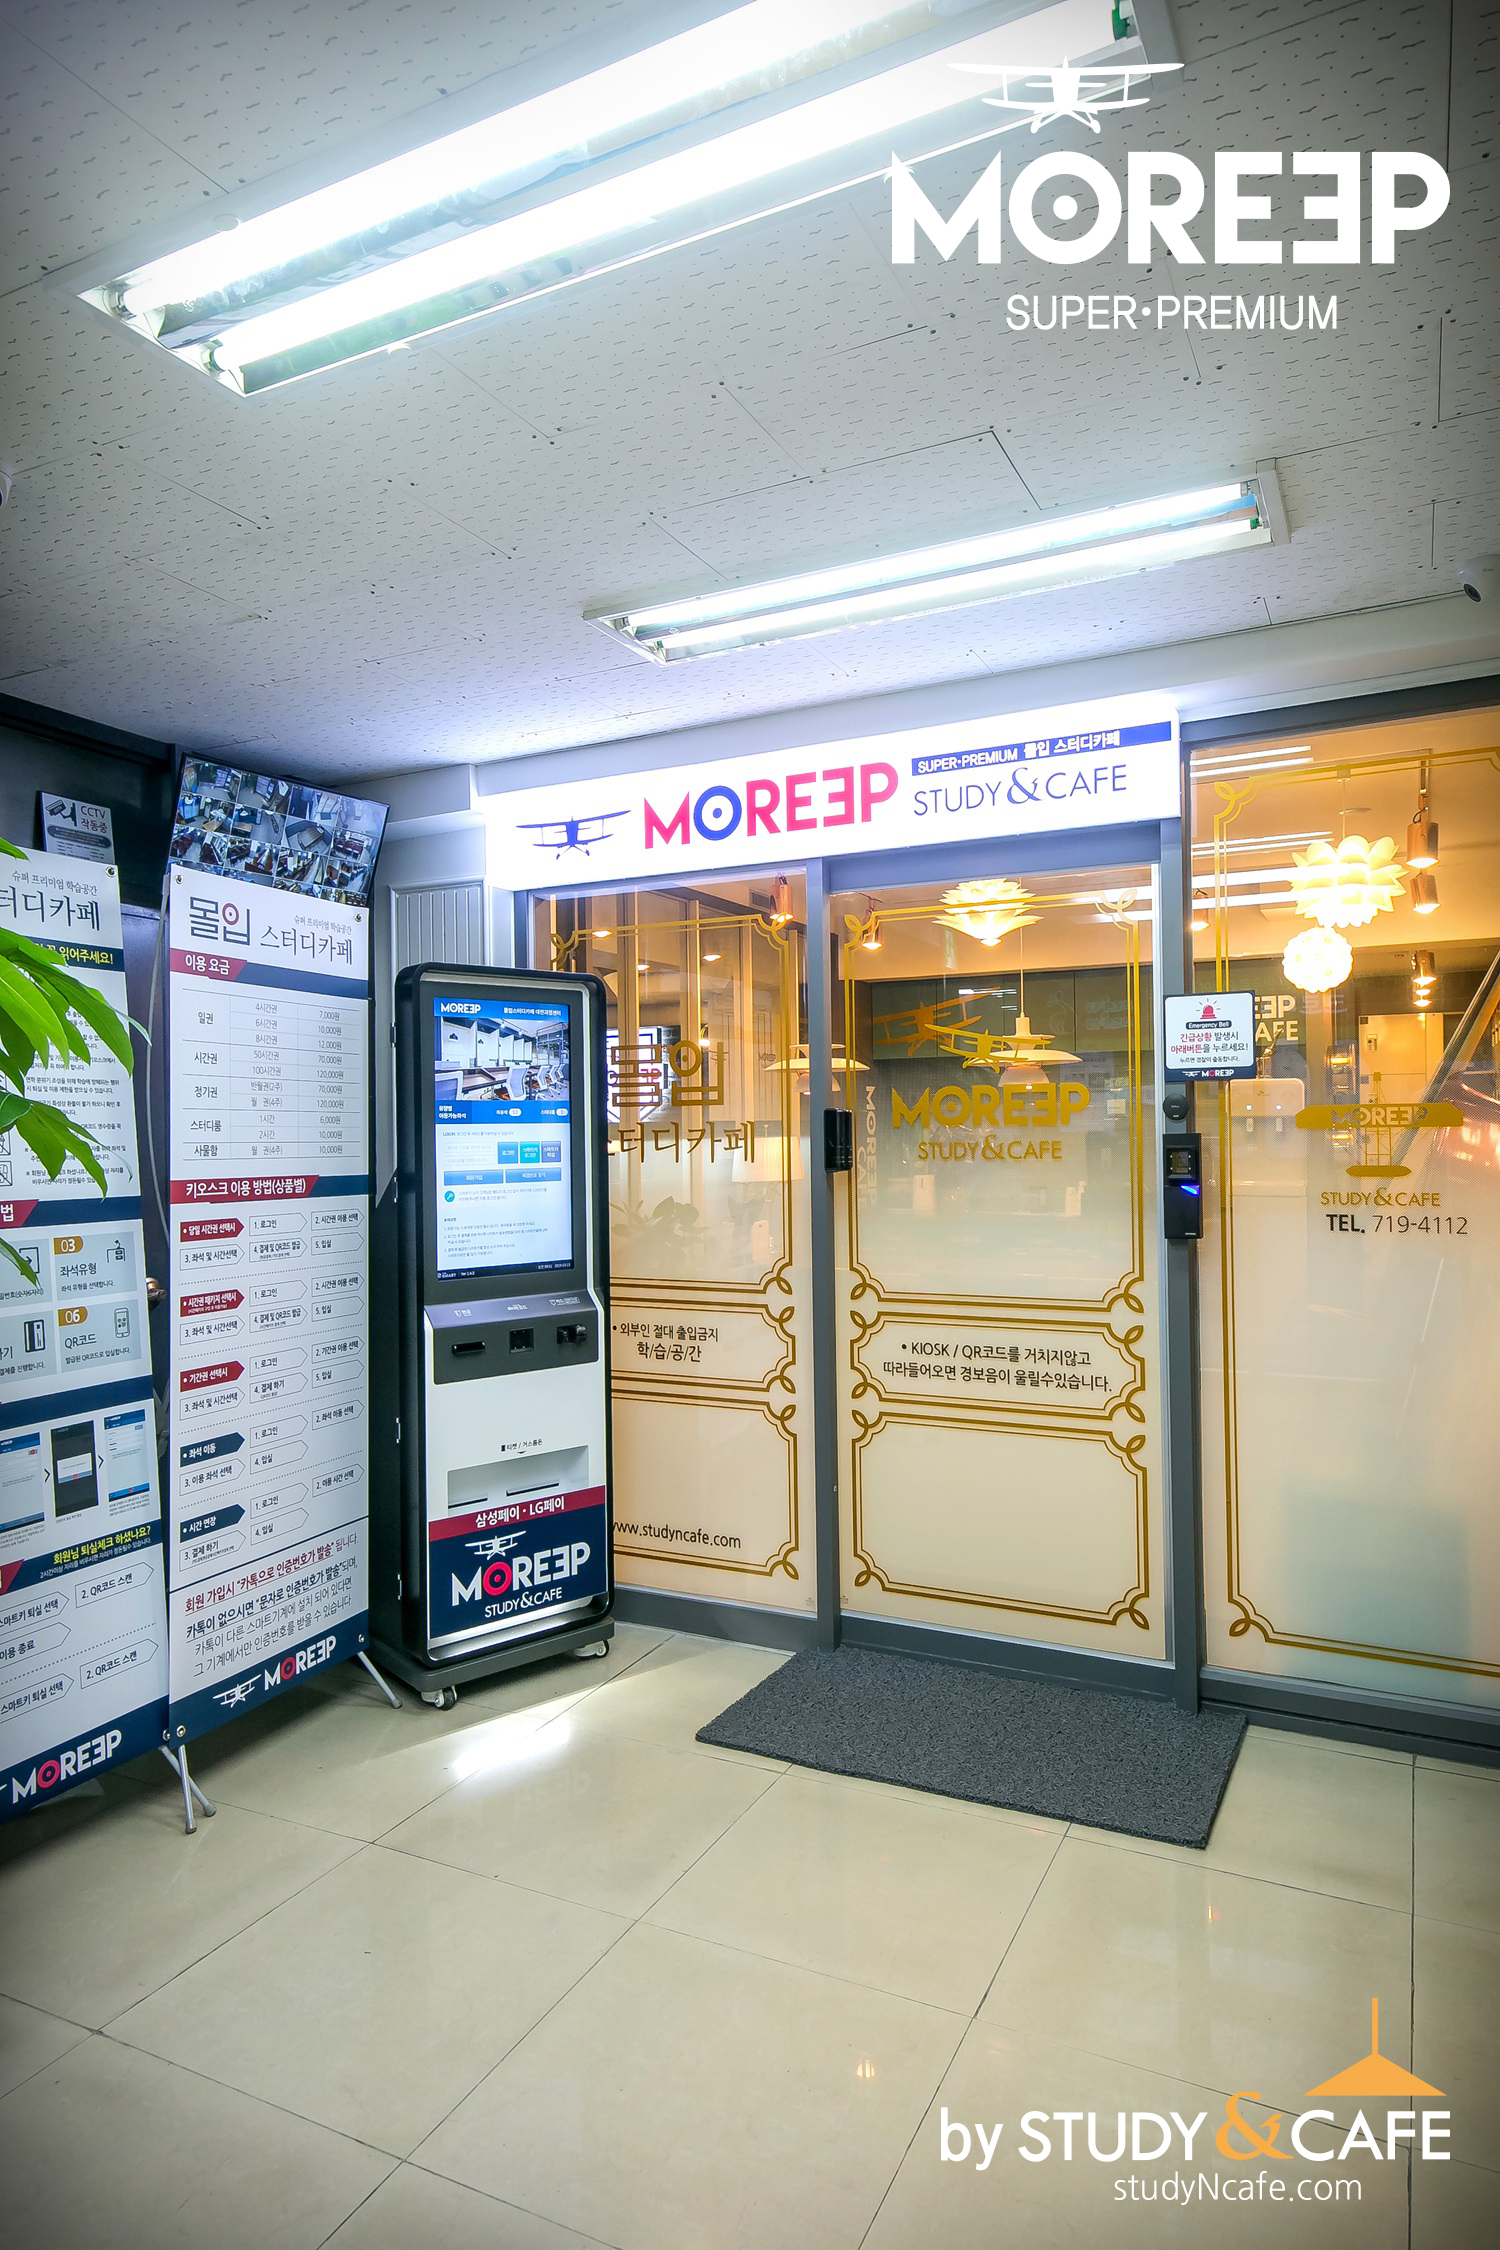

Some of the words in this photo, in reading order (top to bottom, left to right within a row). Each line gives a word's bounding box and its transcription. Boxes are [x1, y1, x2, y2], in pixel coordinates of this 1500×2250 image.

[1023, 740, 1051, 760] 몰입
[1053, 730, 1120, 754] 스터디카페
[80, 805, 106, 819] CCTV
[81, 818, 108, 834] 작동중
[12, 871, 29, 884] 슈퍼
[31, 874, 64, 890] 프리미엄
[66, 881, 98, 896] 학습공간
[189, 896, 251, 946] 몰입
[260, 925, 352, 965] 스터디카페
[185, 954, 207, 972] 이용
[208, 959, 230, 975] 요금
[255, 1004, 278, 1014] 4시간권
[319, 1011, 340, 1021] 7,000원
[198, 1012, 214, 1024] 일권
[255, 1019, 278, 1029] 6시간권
[1188, 1021, 1217, 1029] Emergency
[318, 1025, 342, 1036] 10,000원
[1180, 1032, 1212, 1043] 긴급상황
[1214, 1031, 1239, 1041] 발생시
[255, 1034, 278, 1045] 8시간권
[318, 1040, 342, 1051] 12,000원
[253, 1049, 279, 1061] 50시간권
[1171, 1043, 1211, 1054] 아래버튼을
[1212, 1042, 1249, 1053] 누르세요!
[194, 1053, 218, 1064] 시간권
[318, 1055, 342, 1065] 70,000원
[252, 1066, 281, 1077] 100시간권
[316, 1070, 344, 1080] 120,000원
[610, 1040, 725, 1107] 몰입
[194, 1086, 218, 1098] 정기권
[318, 1084, 342, 1094] 70,000원
[317, 1099, 344, 1109] 120,000원
[190, 1119, 222, 1132] 스터디룸
[259, 1114, 275, 1124] 1시간
[320, 1115, 341, 1124] 6,000원
[258, 1130, 275, 1140] 2시간
[319, 1130, 343, 1140] 10,000원
[194, 1144, 218, 1157] 사물함
[319, 1145, 343, 1155] 10,000원
[917, 1134, 1062, 1161] STUDY&CAFE
[186, 1183, 229, 1198] 키오스크
[230, 1181, 251, 1197] 이용
[252, 1178, 306, 1196] 방법(상품별)
[1320, 1187, 1441, 1207] STUDY&CAFE
[0, 1204, 14, 1222] 법
[201, 1224, 218, 1235] 시간권
[219, 1222, 236, 1233] 선택시
[260, 1219, 277, 1229] 로그인
[1326, 1214, 1365, 1233] TEL.
[1372, 1215, 1468, 1234] 719-4112
[61, 1239, 76, 1253] 03
[321, 1240, 332, 1249] 입실
[60, 1263, 97, 1277] 좌석유형
[65, 1310, 80, 1324] 06
[619, 1322, 650, 1338] 외부인
[653, 1324, 674, 1339] 절대
[676, 1325, 719, 1342] 출입금지
[65, 1334, 97, 1349] QR코드
[911, 1342, 950, 1357] KIOSK
[961, 1344, 1021, 1363] QR코드를
[1024, 1347, 1091, 1367] 거치지않고
[189, 1372, 208, 1383] 기간권
[209, 1367, 228, 1380] 선택시
[883, 1361, 956, 1381] 따라들어오면
[960, 1365, 1010, 1385] 경보음이
[1013, 1369, 1112, 1392] 울릴수있습니다.
[189, 1447, 202, 1458] 좌석
[203, 1443, 216, 1454] 이동
[475, 1506, 520, 1528] 삼성페이
[529, 1496, 565, 1516] LG페이
[189, 1520, 202, 1532] 시간
[203, 1516, 217, 1529] 연장
[53, 1547, 79, 1565] 회원님
[81, 1537, 114, 1553] 퇴실체크
[115, 1526, 151, 1542] 하셨나요?
[185, 1596, 204, 1612] 회원
[207, 1582, 234, 1603] 가입시
[276, 1549, 315, 1577] 인증번호가
[335, 1533, 358, 1552] 됩니다.
[27, 1604, 42, 1618] 퇴실
[43, 1599, 59, 1612] 선택
[186, 1616, 215, 1638] 카톡이
[217, 1600, 254, 1627] 없으시면
[286, 1570, 324, 1599] 인증번호가
[484, 1587, 563, 1618] STUDY&CAFE
[195, 1633, 224, 1655] 카톡이
[226, 1626, 243, 1641] 다른
[247, 1602, 295, 1635] 스마트기계에
[297, 1597, 313, 1612] 설치
[314, 1586, 330, 1603] 되어
[331, 1576, 352, 1598] 있다면
[193, 1662, 204, 1677] 그
[206, 1642, 252, 1671] 기계에서만
[254, 1622, 295, 1651] 인증번호를
[296, 1612, 312, 1630] 받을
[314, 1610, 322, 1622] 수
[323, 1594, 353, 1616] 있습니다.
[17, 1640, 36, 1655] 종료
[86, 1670, 94, 1680] 2.
[95, 1658, 121, 1675] QR코드
[122, 1650, 137, 1664] 스캔
[0, 1694, 31, 1715] 스마트키
[32, 1688, 47, 1702] 퇴실
[48, 1681, 64, 1695] 선택
